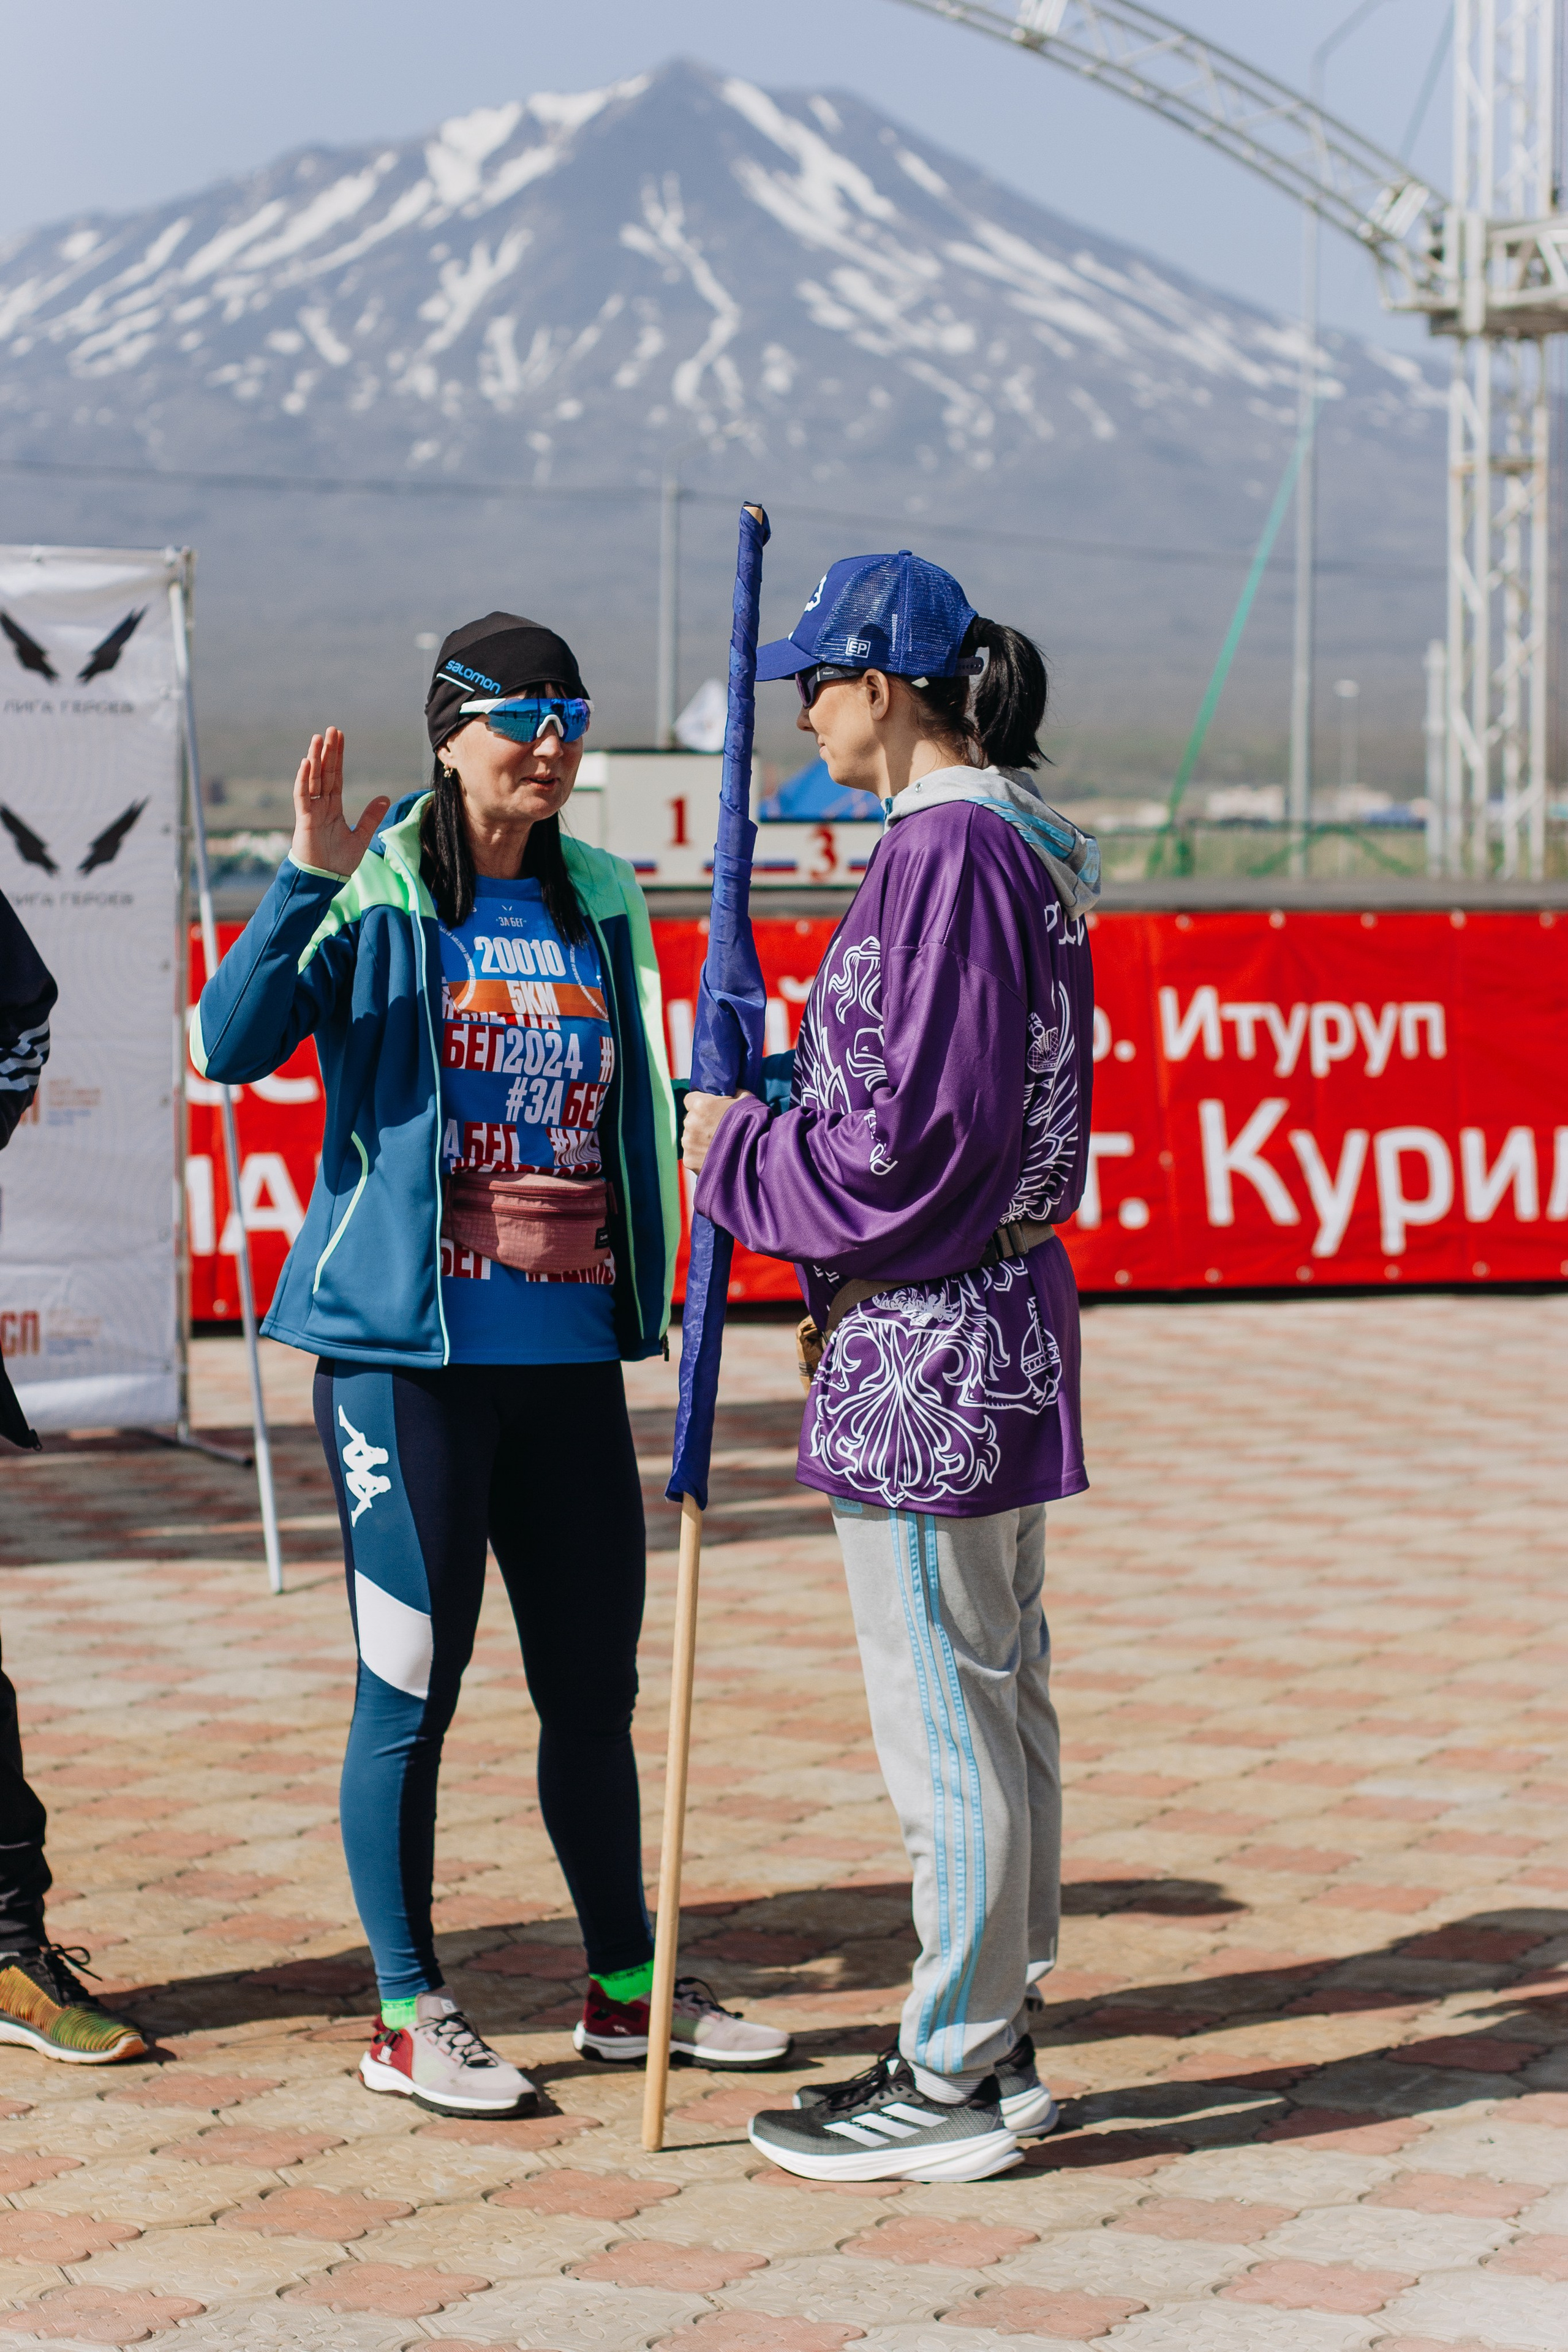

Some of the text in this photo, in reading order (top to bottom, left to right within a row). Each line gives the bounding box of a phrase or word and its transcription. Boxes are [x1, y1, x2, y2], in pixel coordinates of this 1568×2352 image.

[848, 641, 867, 654] EP
[667, 795, 691, 848] 1
[809, 823, 839, 881] 3
[473, 937, 566, 976] 20010
[1158, 985, 1449, 1079] Итуруп
